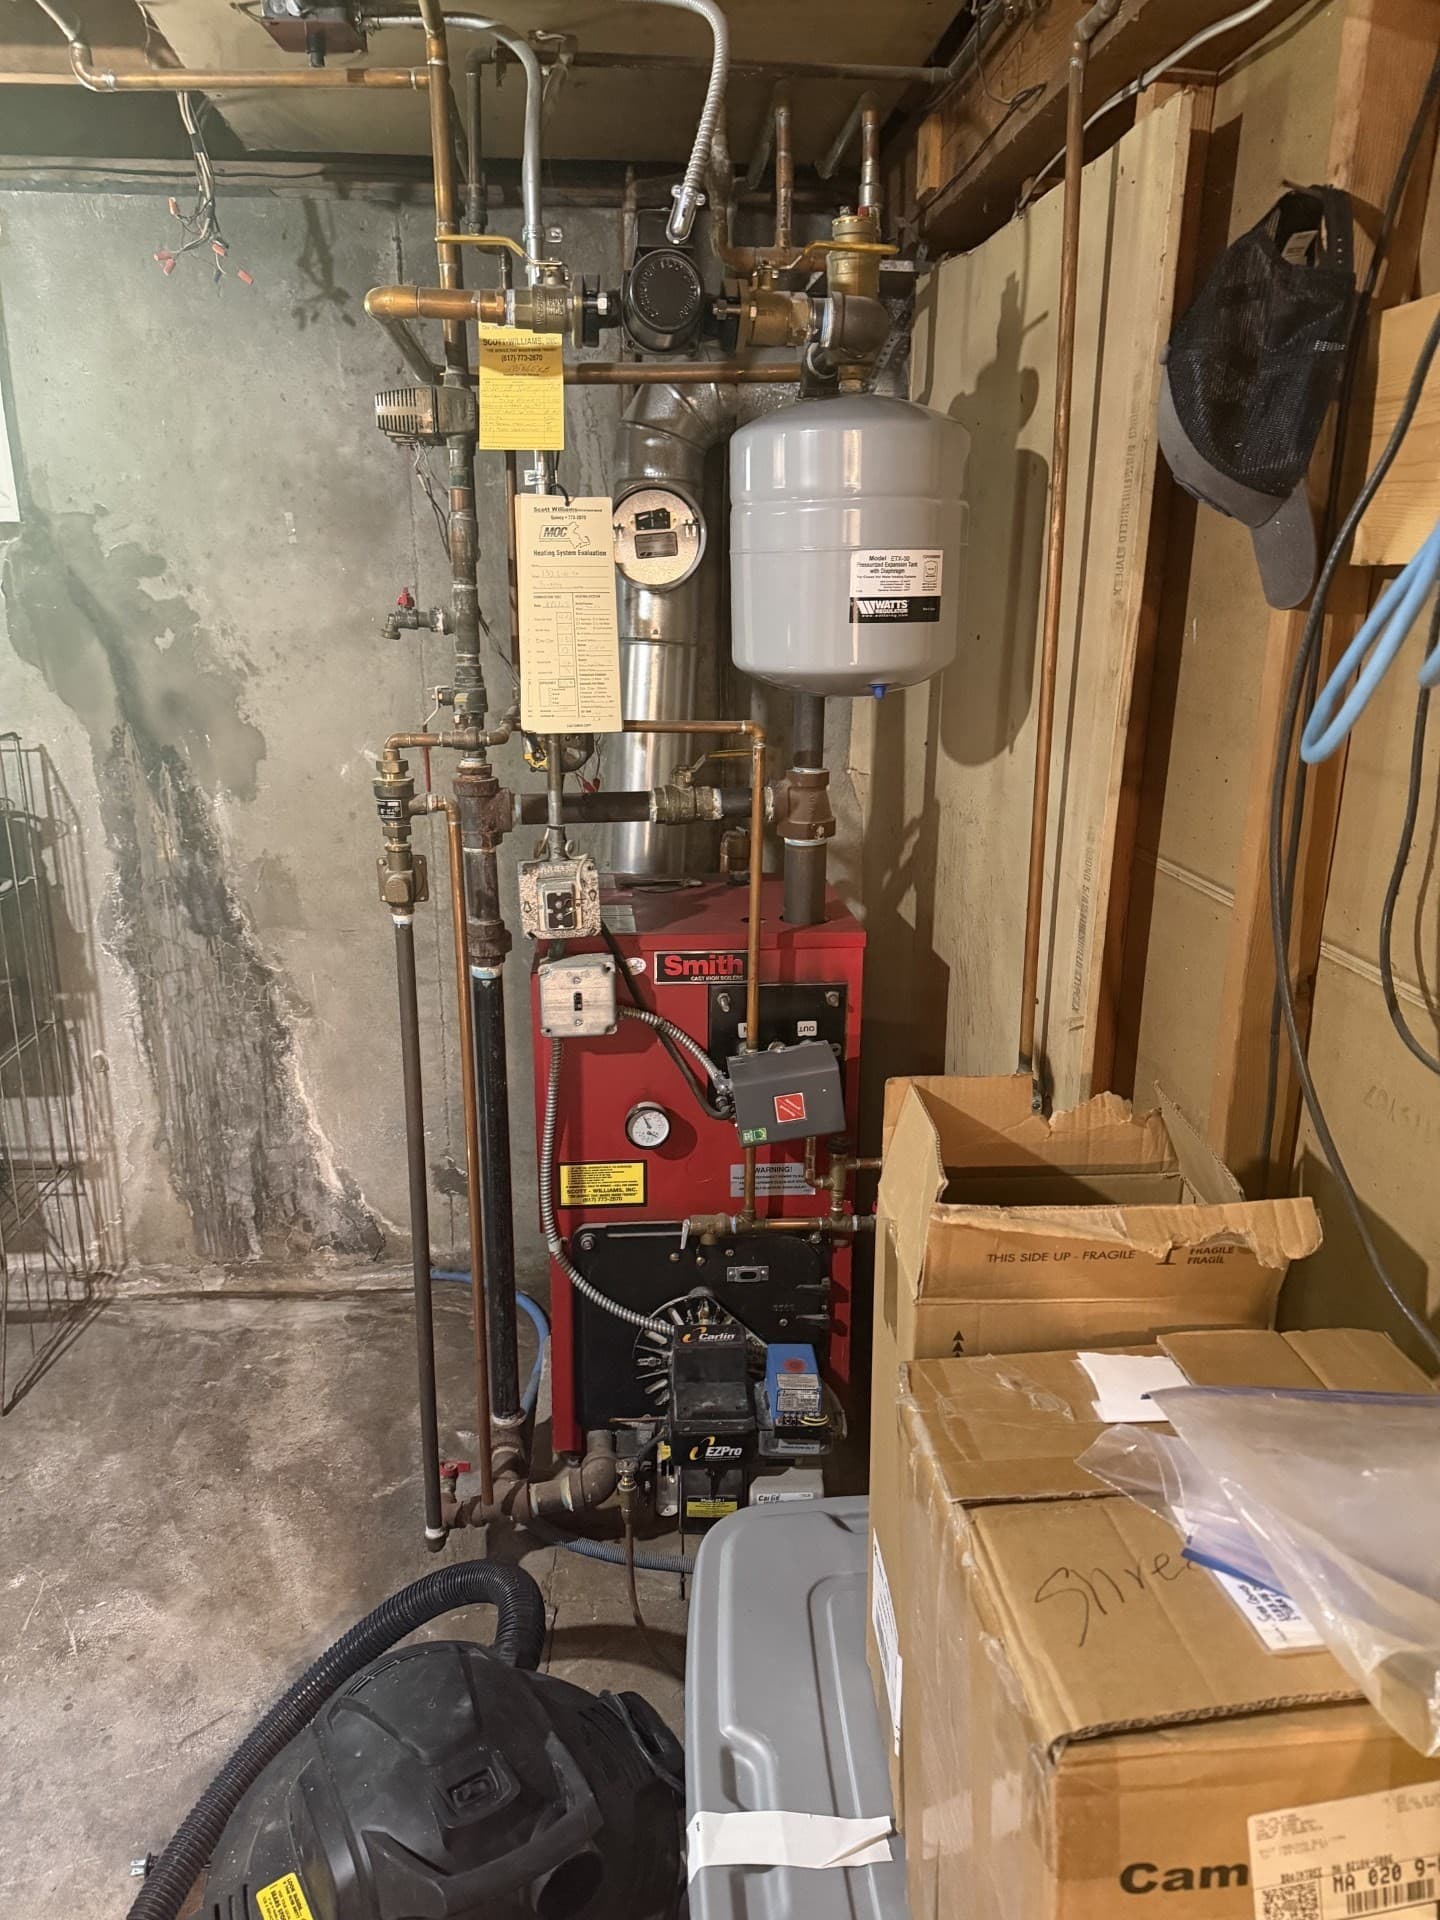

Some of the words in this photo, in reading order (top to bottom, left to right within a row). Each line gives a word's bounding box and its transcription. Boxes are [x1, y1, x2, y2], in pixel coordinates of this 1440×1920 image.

[543, 526, 568, 537] MOC
[556, 549, 576, 557] System
[875, 600, 908, 608] WATTS
[664, 954, 743, 976] Smith
[799, 1024, 815, 1033] OUT
[987, 1253, 1017, 1263] THIS
[1020, 1252, 1049, 1262] SIDE
[1053, 1251, 1071, 1261] UP
[1082, 1249, 1137, 1261] FRAGILE
[698, 1332, 736, 1341] Carlin
[705, 1446, 743, 1456] EZPro
[1120, 1861, 1249, 1895] Cam
[1333, 1875, 1356, 1893] MA
[1368, 1865, 1402, 1886] 020
